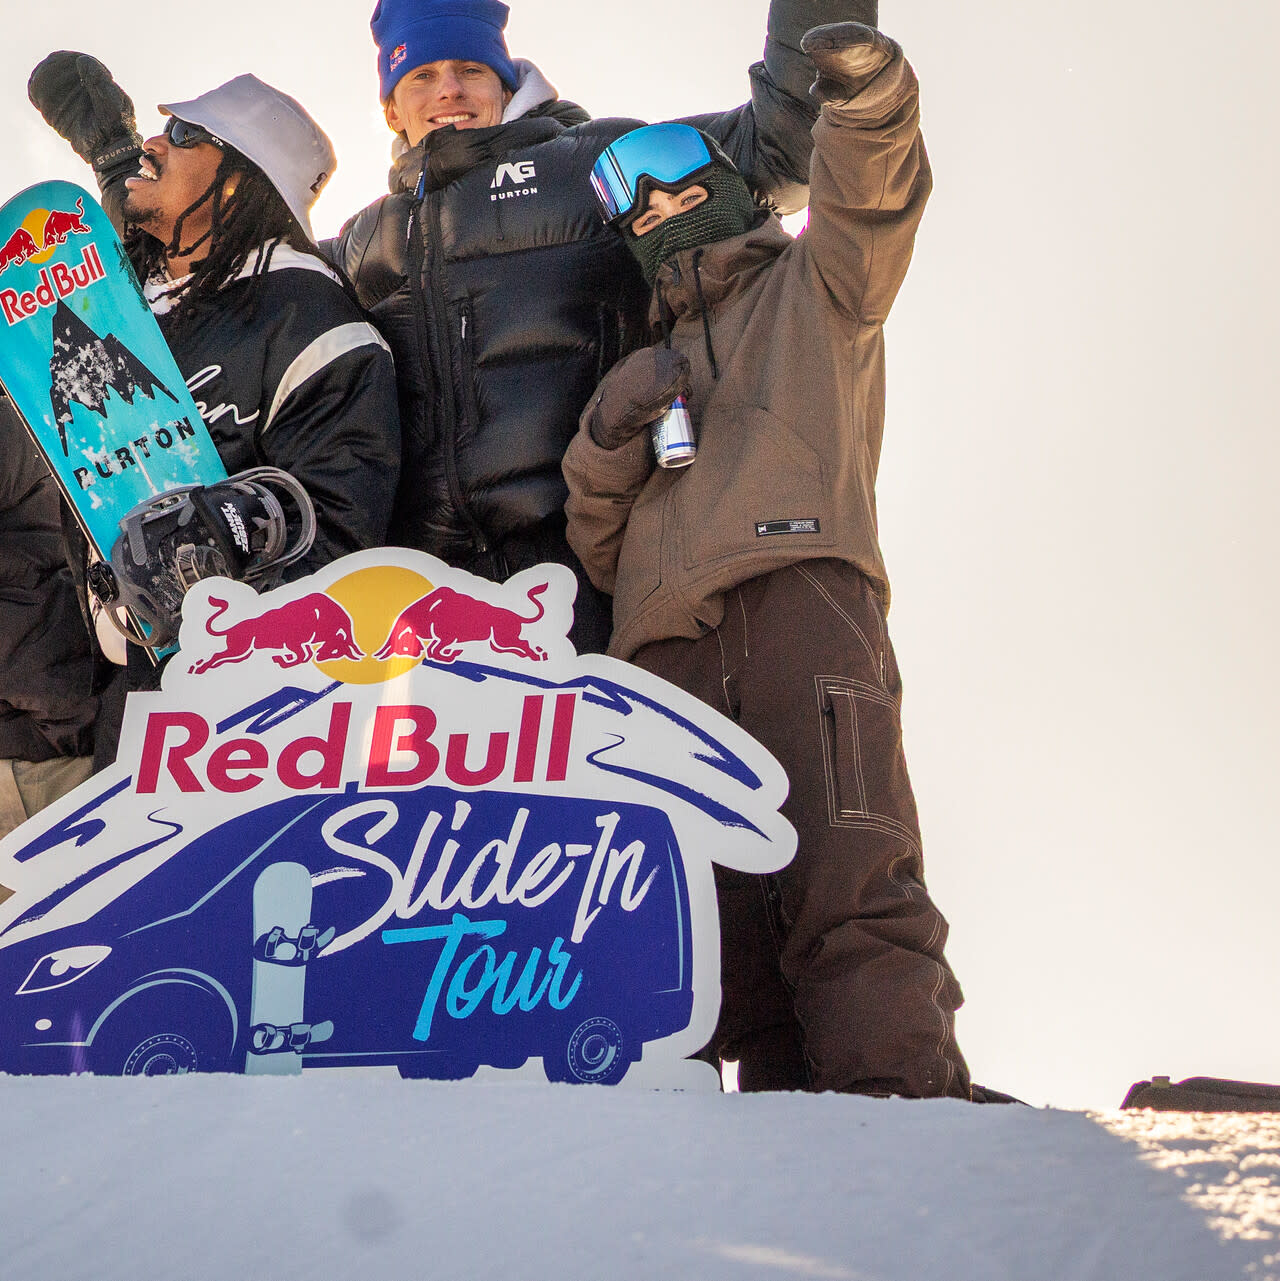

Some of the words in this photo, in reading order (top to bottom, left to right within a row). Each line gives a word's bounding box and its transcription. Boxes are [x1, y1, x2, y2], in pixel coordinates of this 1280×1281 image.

[104, 143, 139, 160] BURTON
[490, 187, 538, 202] BURTON
[52, 242, 106, 299] Bull
[136, 701, 353, 794] Red
[365, 693, 577, 788] Bull
[310, 798, 659, 959] Slide-In
[381, 912, 584, 1042] Tour
